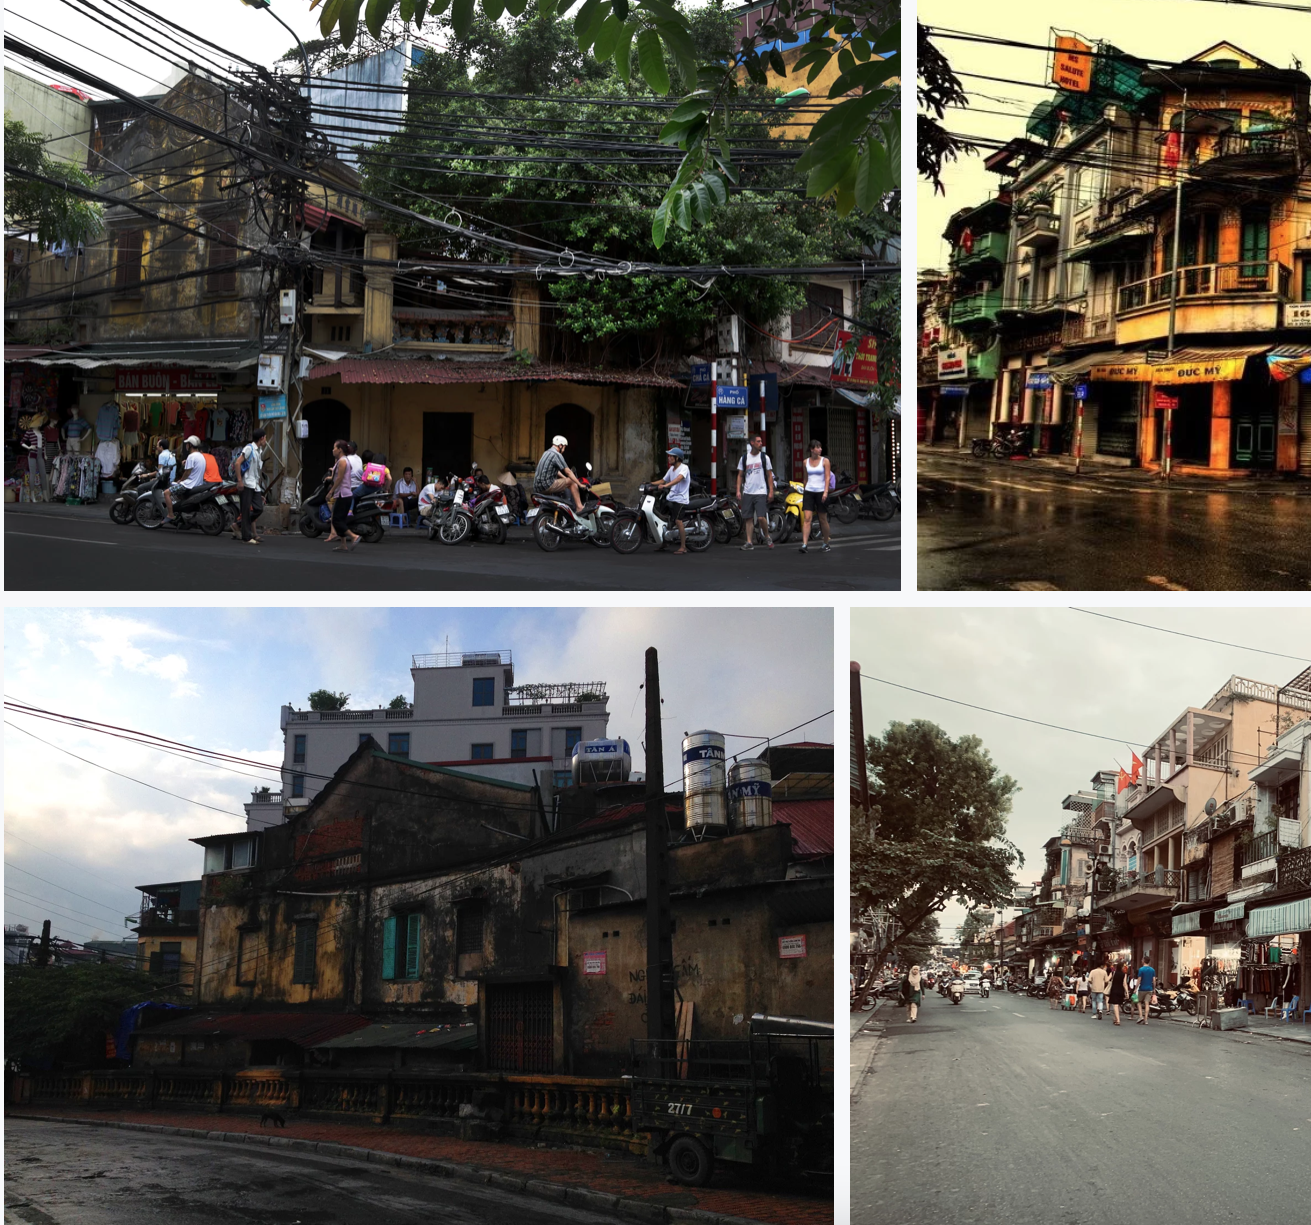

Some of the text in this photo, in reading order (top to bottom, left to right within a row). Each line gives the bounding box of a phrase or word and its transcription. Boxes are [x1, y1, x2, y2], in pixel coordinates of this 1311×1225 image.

[1060, 76, 1080, 88] HOTEL
[119, 371, 169, 388] BÁN BUÔN
[719, 395, 745, 405] HÀNG CÁ
[740, 783, 760, 796] MỸ
[668, 1102, 693, 1116] 27/7
